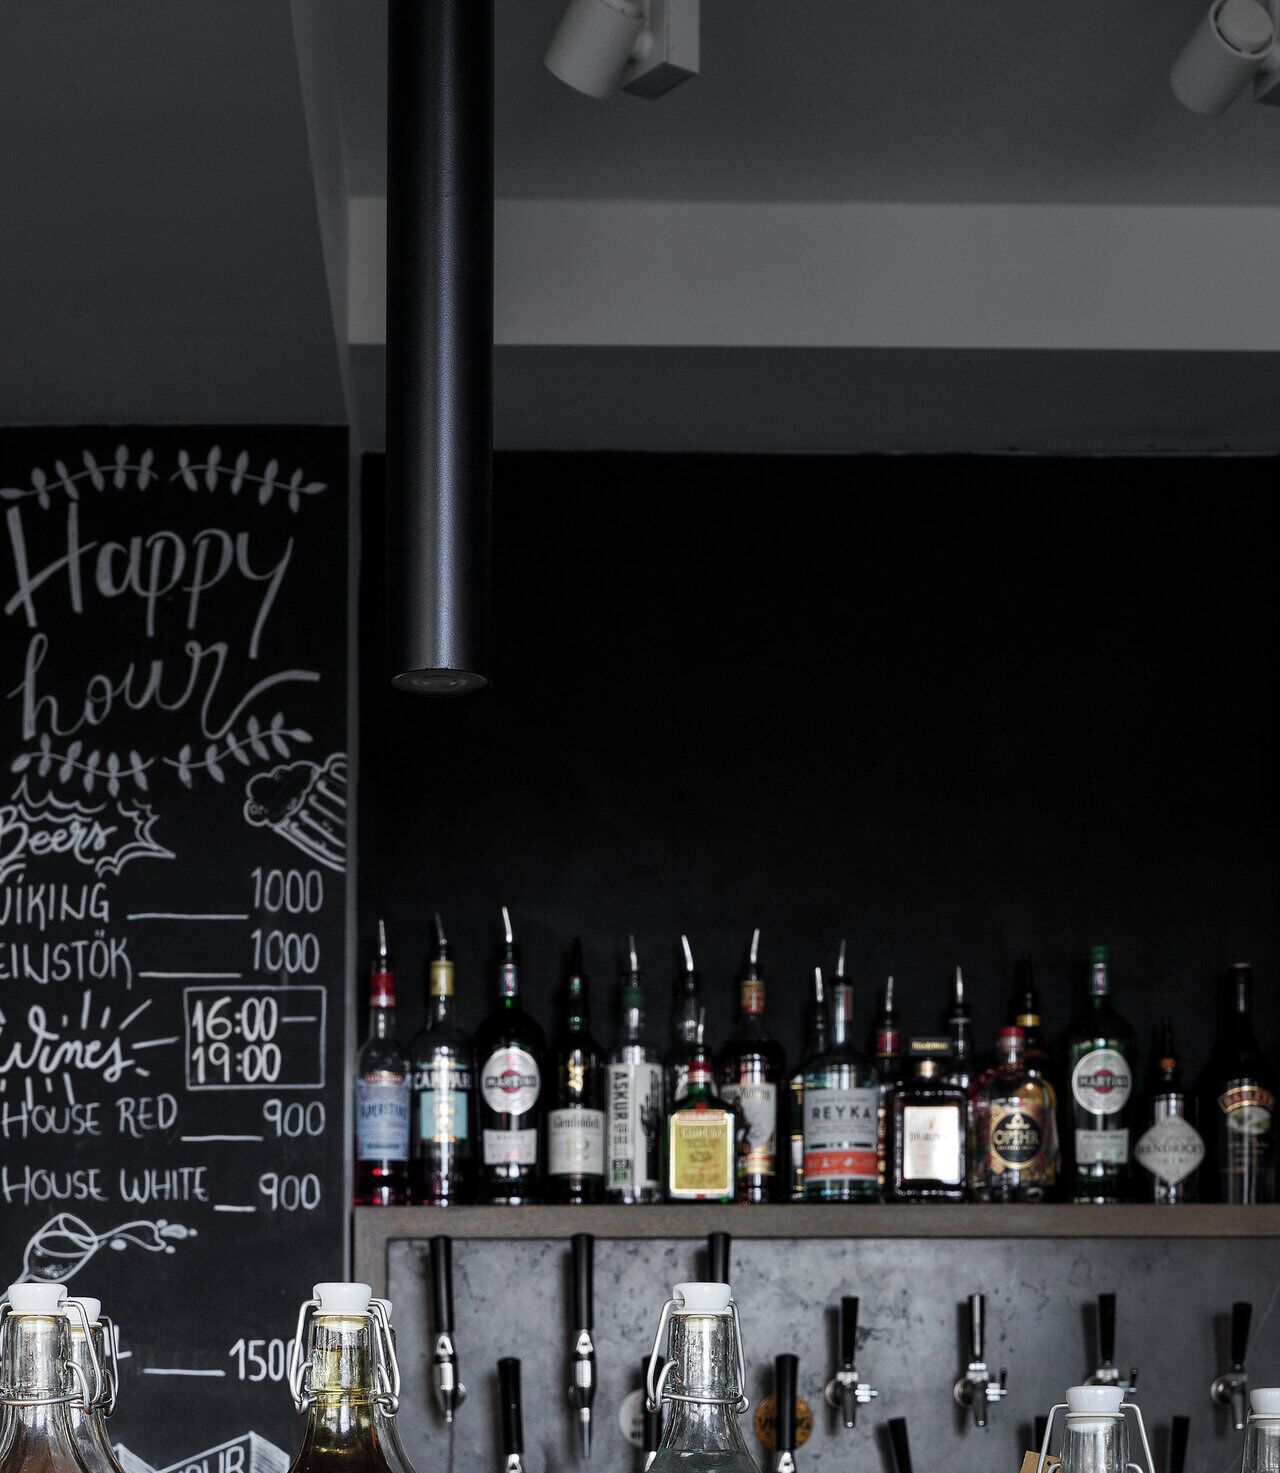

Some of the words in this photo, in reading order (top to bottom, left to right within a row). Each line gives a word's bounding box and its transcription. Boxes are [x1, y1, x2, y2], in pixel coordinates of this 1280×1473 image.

[3, 500, 295, 660] Happy
[6, 631, 322, 741] hour
[250, 866, 324, 914] 1000
[250, 927, 320, 974] 1000
[191, 996, 279, 1043] 16:00
[192, 1042, 282, 1085] 19:00
[1078, 1075, 1129, 1089] MARTINI
[1, 1098, 102, 1139] HOUSE
[116, 1093, 178, 1140] RED
[262, 1097, 325, 1138] 900
[612, 1071, 629, 1120] ASKUR
[811, 1104, 873, 1121] REYKA
[2, 1166, 102, 1206] HOUSE
[119, 1165, 208, 1203] WHITE
[259, 1172, 321, 1212] 900
